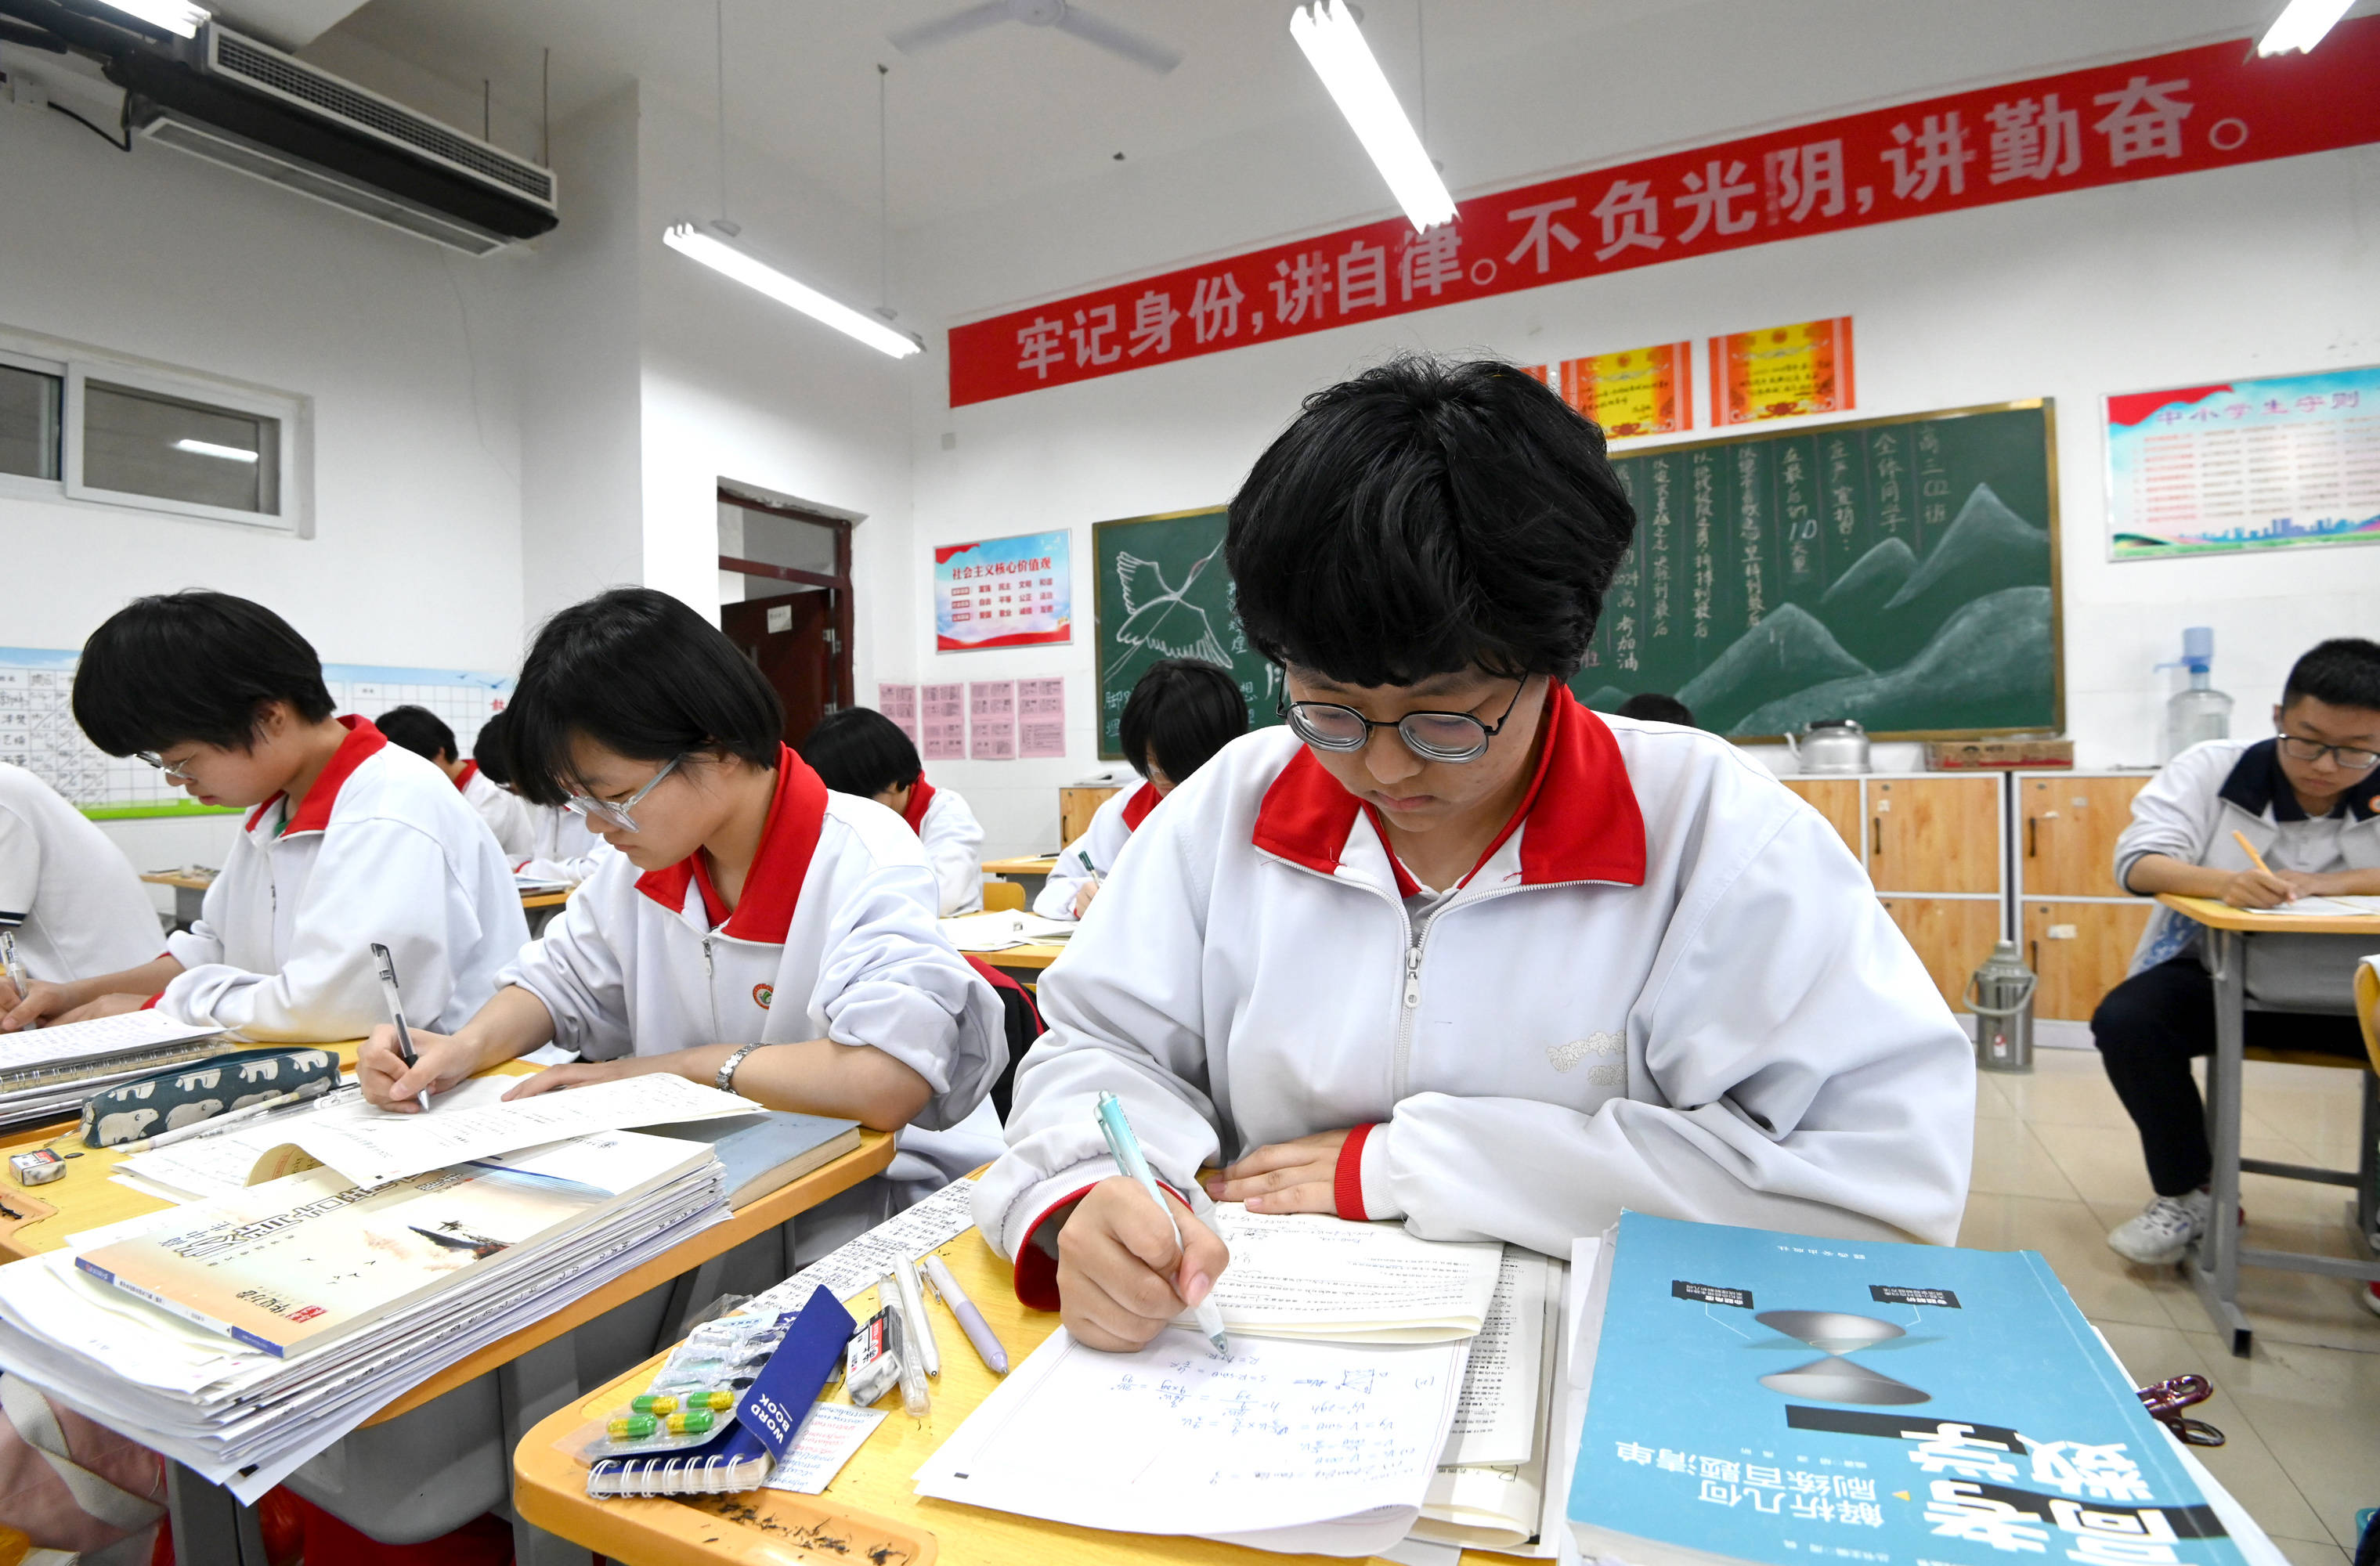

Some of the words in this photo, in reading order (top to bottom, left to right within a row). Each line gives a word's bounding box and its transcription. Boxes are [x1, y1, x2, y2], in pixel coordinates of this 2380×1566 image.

[1873, 432, 1906, 532] 全体同学
[952, 557, 1051, 579] 社会主义核心价值观
[172, 1167, 443, 1257] 必背古诗
[751, 1404, 784, 1444] WORD
[759, 1394, 790, 1432] BOOK
[1616, 1441, 1877, 1501] 刷练百题清单
[1901, 1420, 2158, 1503] 数学
[1698, 1480, 1885, 1528] 解析几何
[1923, 1479, 2202, 1566] 高考
